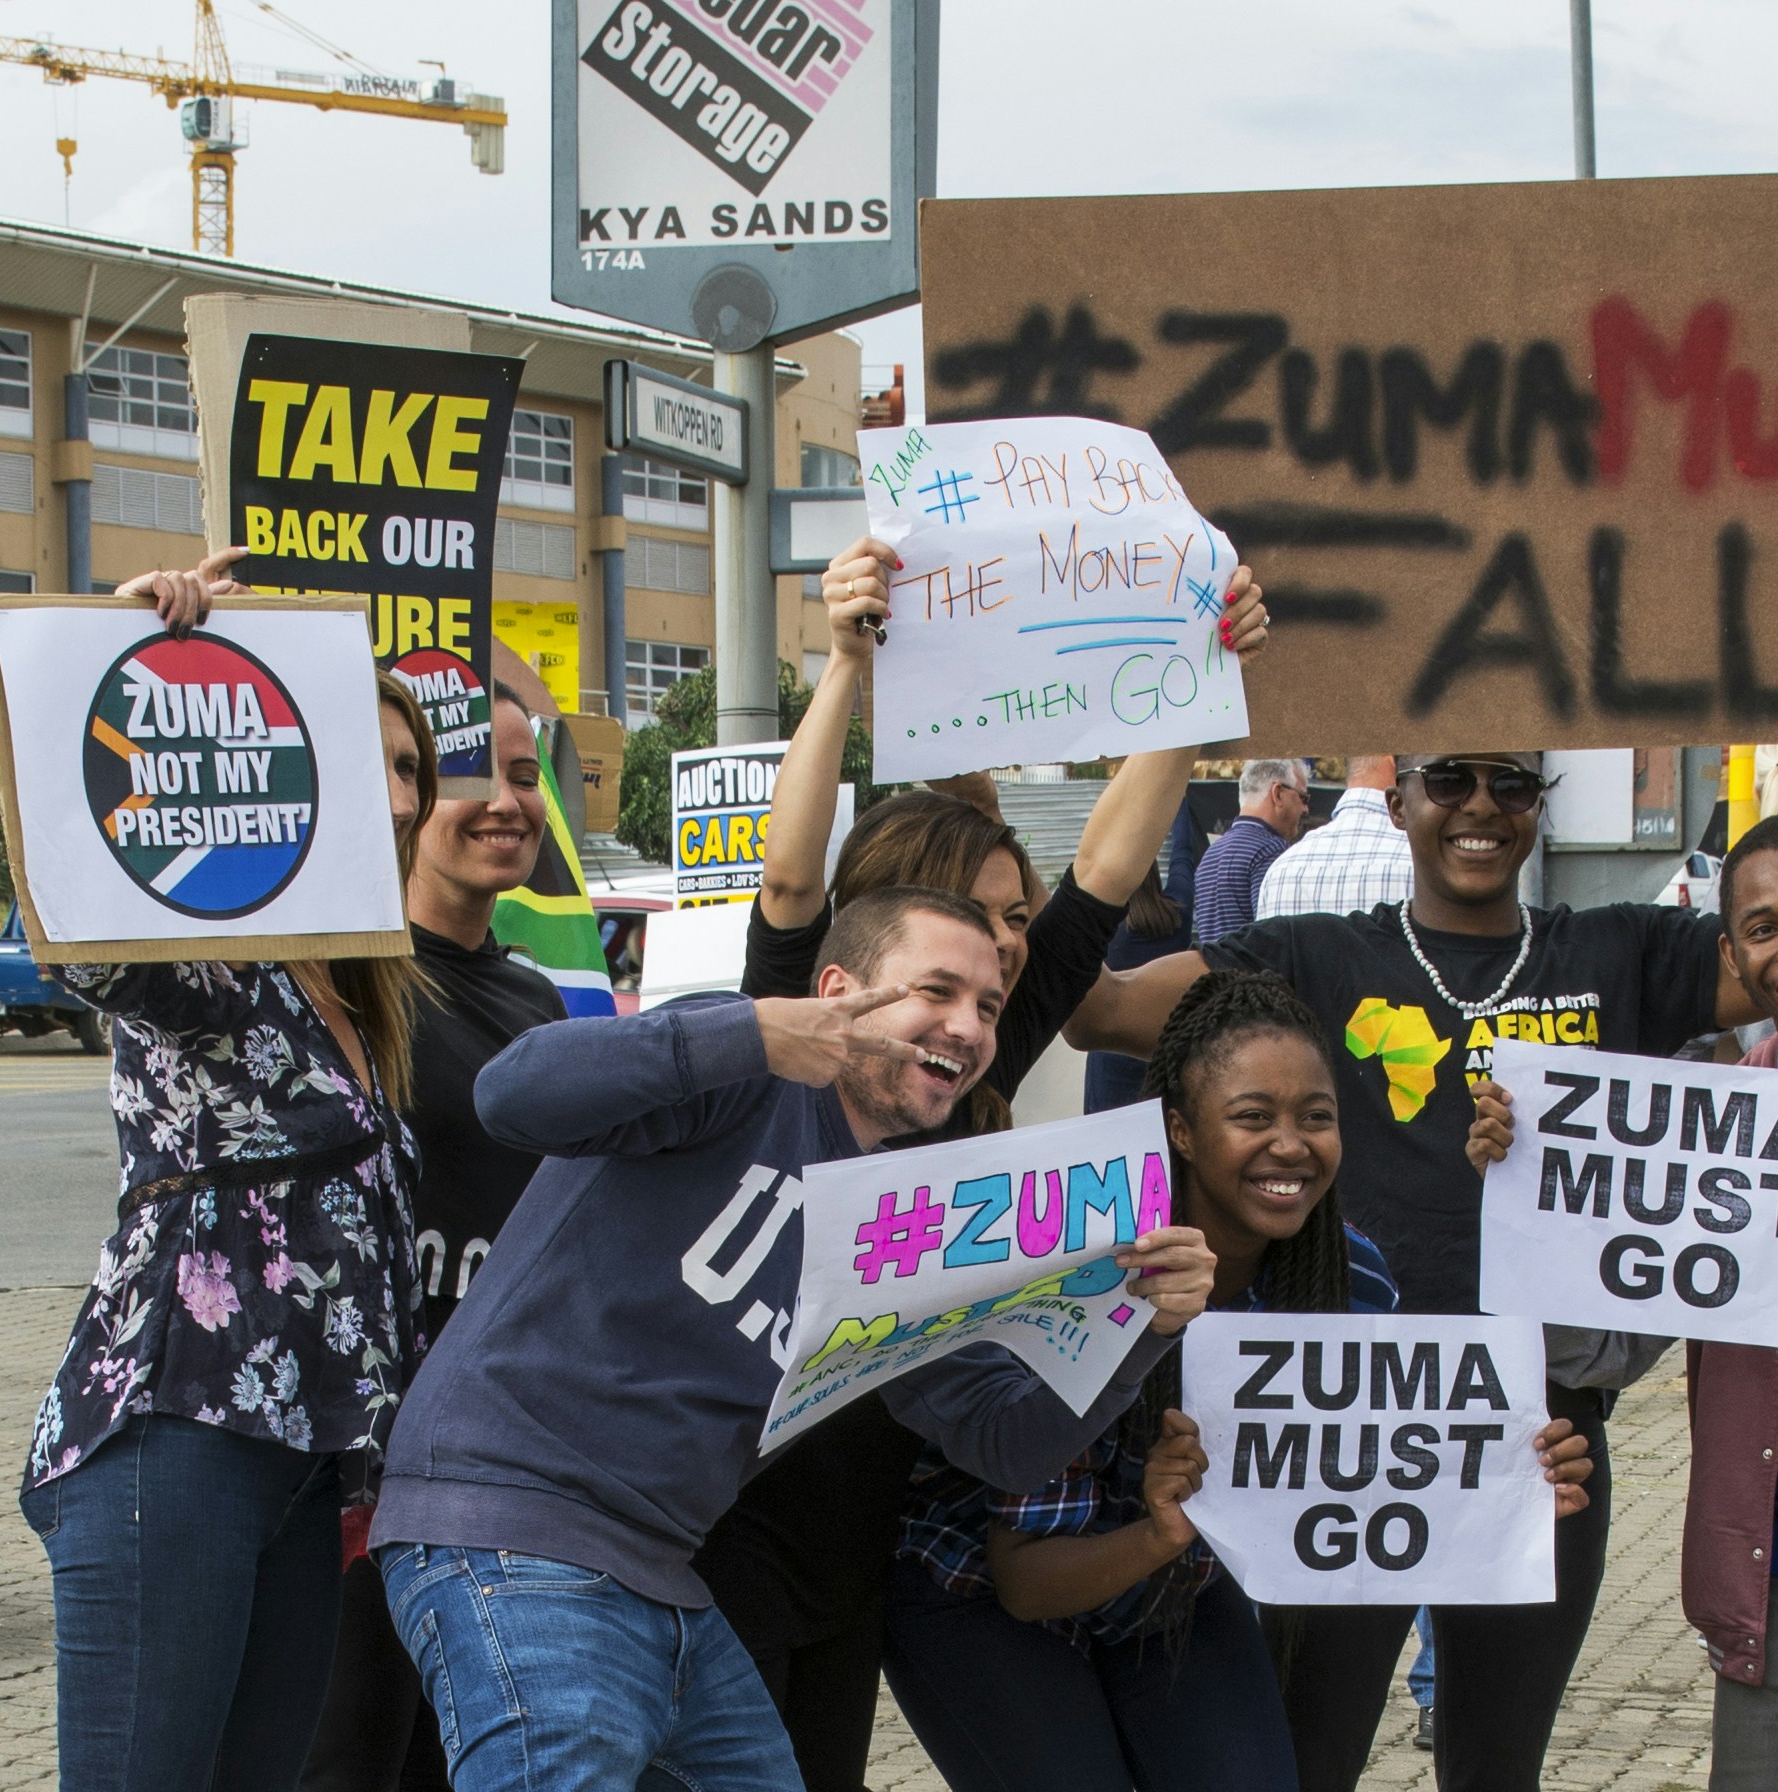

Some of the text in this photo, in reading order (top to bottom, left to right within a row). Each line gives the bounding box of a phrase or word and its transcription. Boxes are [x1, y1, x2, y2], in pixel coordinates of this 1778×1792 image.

[602, 3, 791, 175] Storage
[580, 199, 890, 242] KYA SANDS
[581, 250, 646, 272] 174A
[246, 379, 489, 492] TAKE
[653, 395, 724, 452] WITKOPPEN RD
[871, 428, 932, 506] ZUMA
[245, 506, 475, 571] BACK OUR
[892, 556, 1013, 621] THE
[123, 681, 269, 742] ZUMA
[413, 668, 466, 703] UMA
[440, 700, 469, 728] MY
[434, 730, 486, 755] IDENT
[130, 750, 271, 795] NOT MY
[113, 806, 307, 849] PRESIDENT
[1463, 996, 1538, 1020] BUILDING
[1541, 1000, 1554, 1011] A
[1465, 1010, 1599, 1049] AFRICA
[1465, 1050, 1493, 1070] AN
[854, 1152, 1172, 1285] #ZUMA
[1600, 1233, 1743, 1310] GO
[1233, 1337, 1510, 1413] ZUMA
[1231, 1421, 1505, 1494] MUST
[1293, 1501, 1431, 1572] GO
